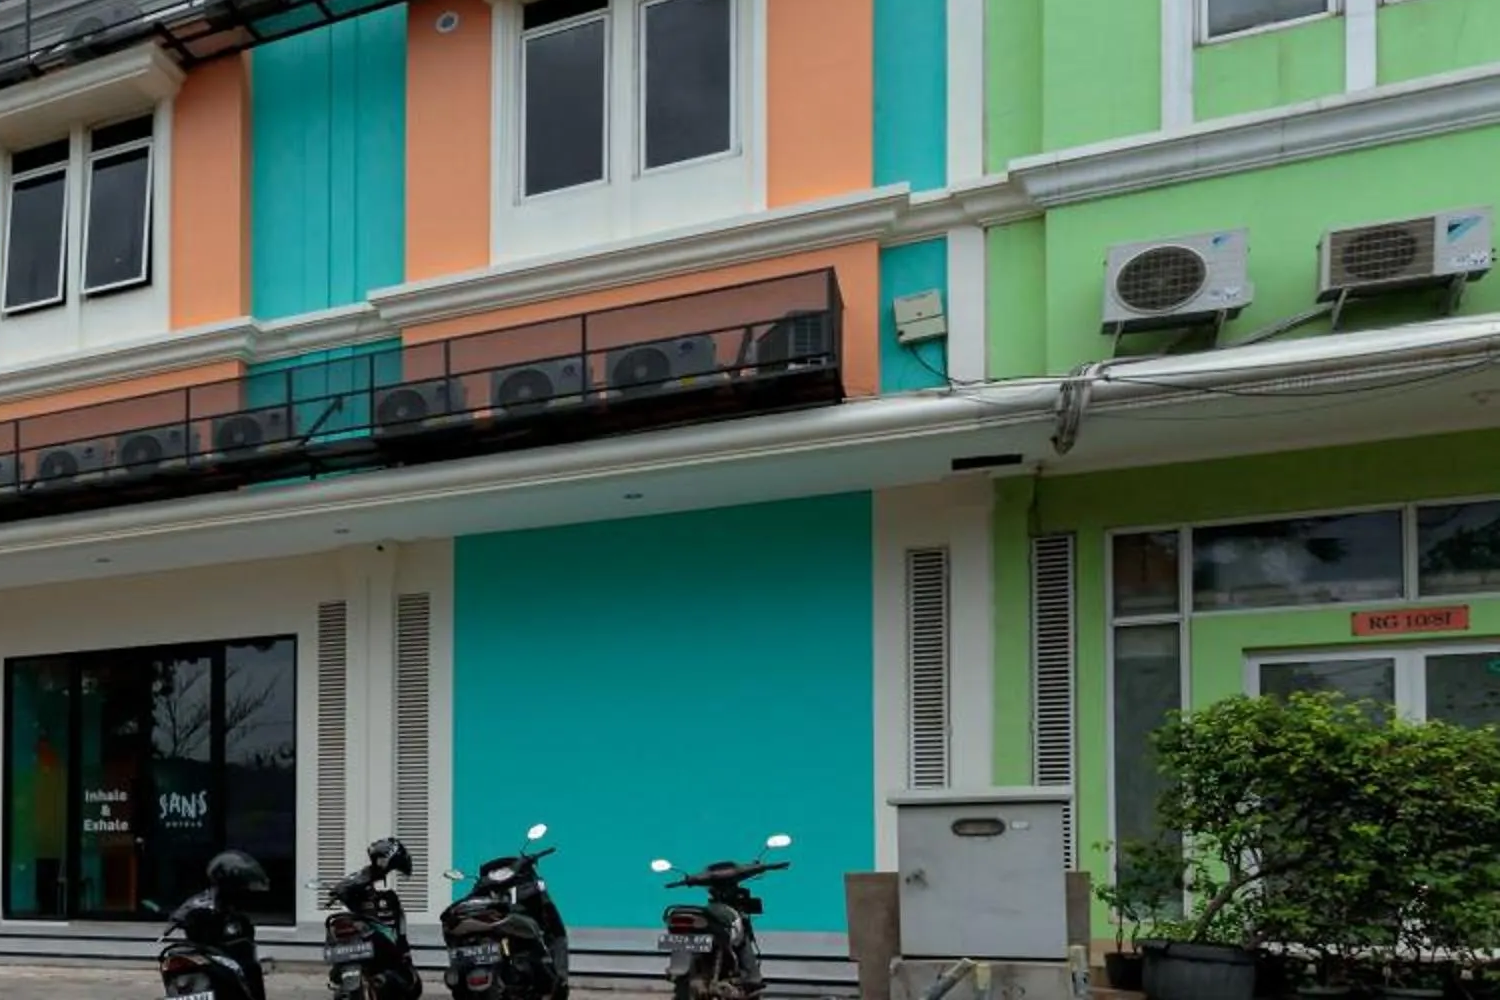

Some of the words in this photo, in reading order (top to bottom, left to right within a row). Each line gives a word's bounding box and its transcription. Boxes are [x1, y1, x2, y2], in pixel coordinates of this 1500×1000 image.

[84, 788, 128, 802] Inhale
[159, 789, 208, 819] SANS
[83, 818, 129, 831] Exhale
